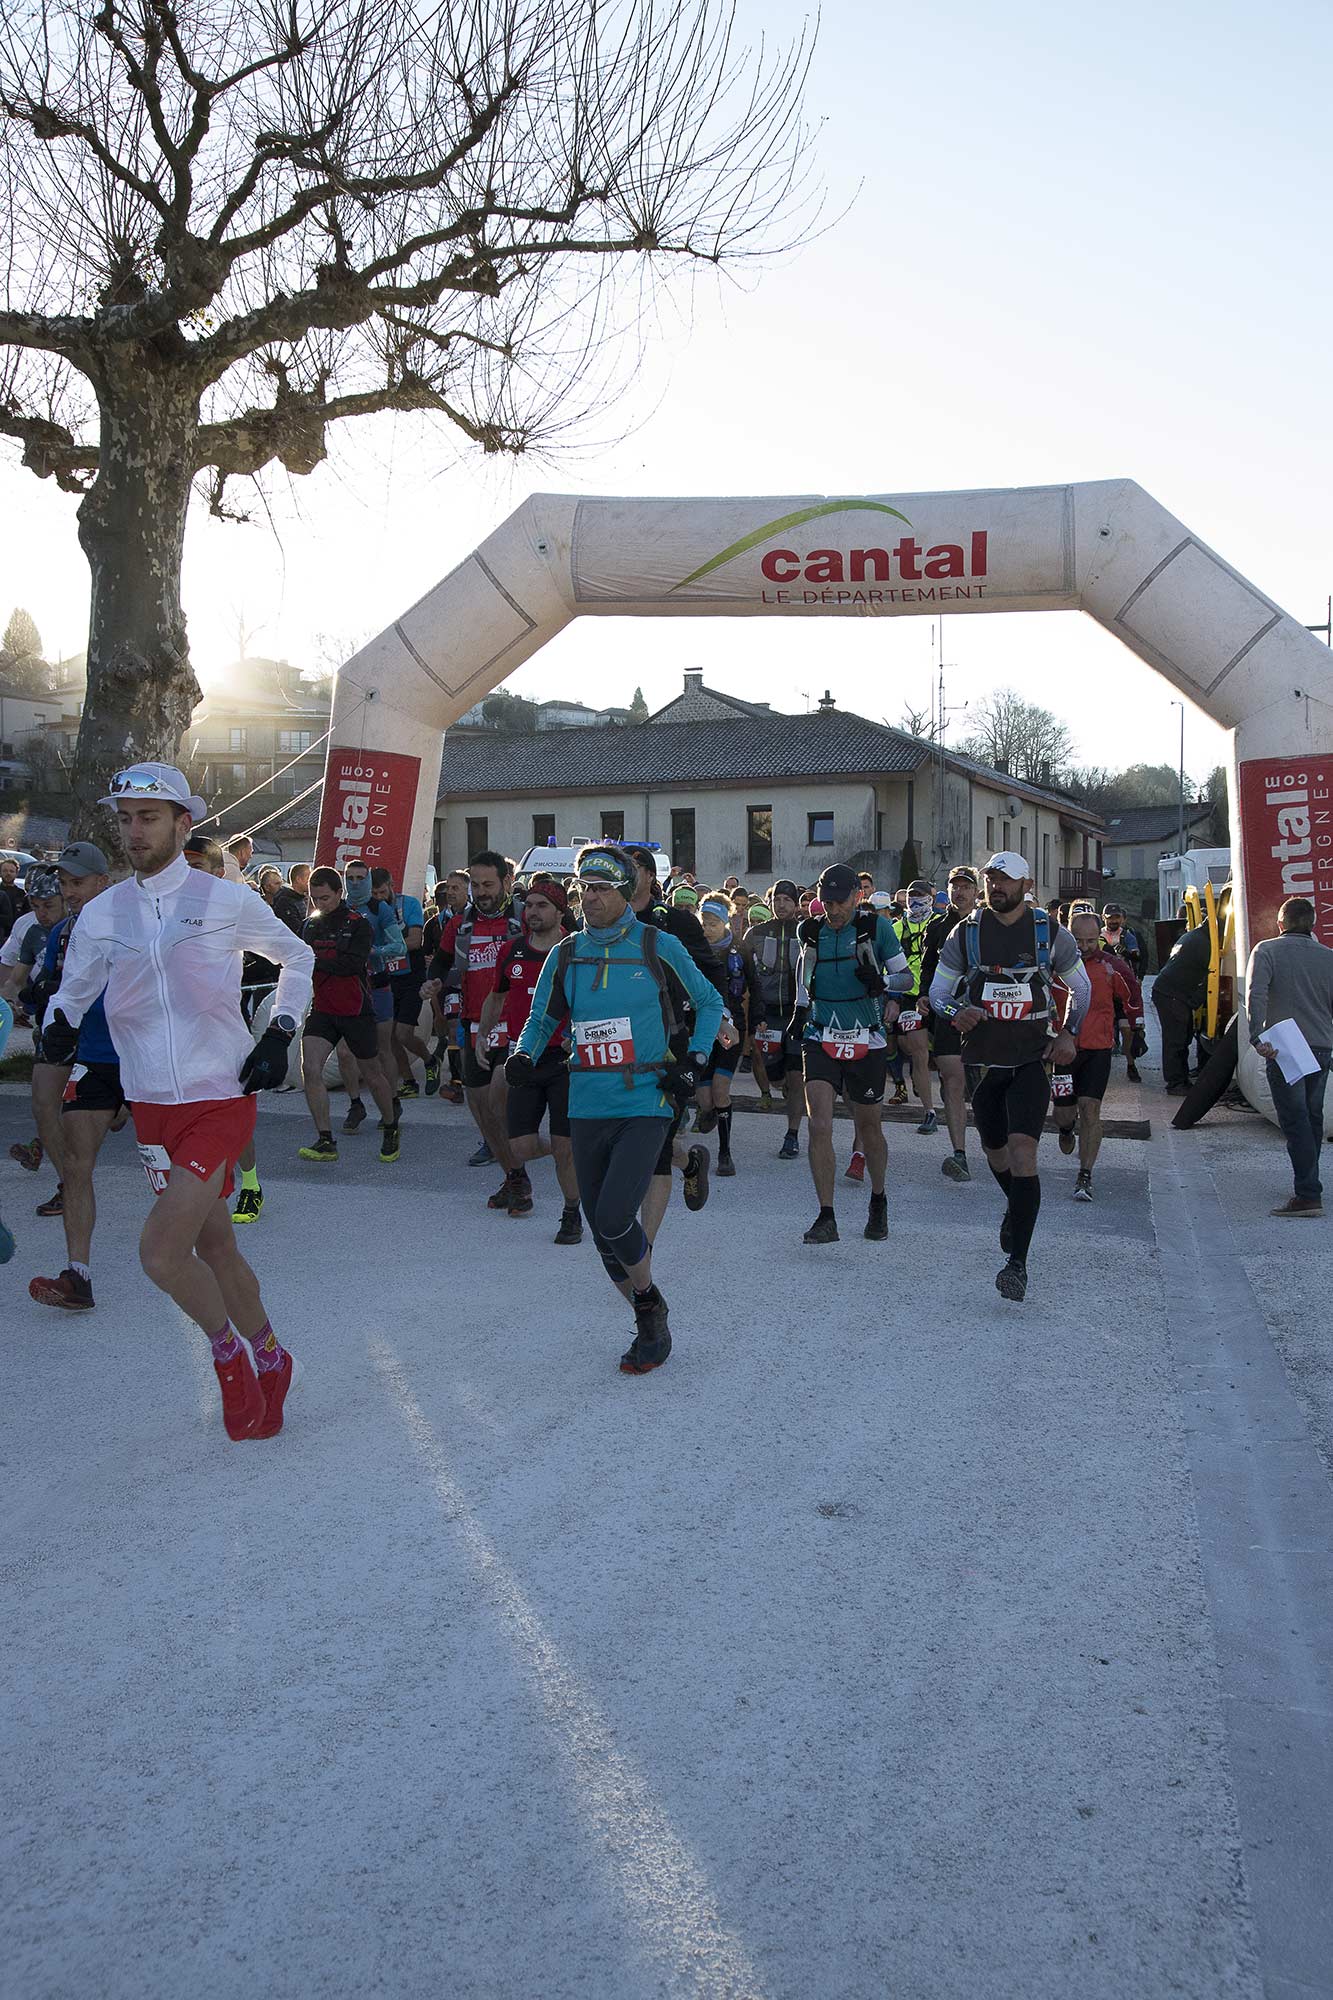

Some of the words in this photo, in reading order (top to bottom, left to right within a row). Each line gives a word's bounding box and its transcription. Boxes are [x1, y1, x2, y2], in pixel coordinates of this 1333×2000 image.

[761, 530, 988, 583] cantal
[762, 589, 789, 604] LE
[804, 584, 988, 604] DÉPARTEMENT
[333, 780, 372, 872] ntal
[366, 783, 391, 857] RGNE
[1266, 789, 1317, 908] ntal
[1313, 788, 1333, 936] UVERGNE
[387, 961, 400, 972] 87
[990, 1002, 1024, 1020] 107
[900, 1020, 917, 1032] 122
[584, 1042, 624, 1066] 119
[835, 1043, 855, 1059] 75
[1051, 1083, 1074, 1097] 123
